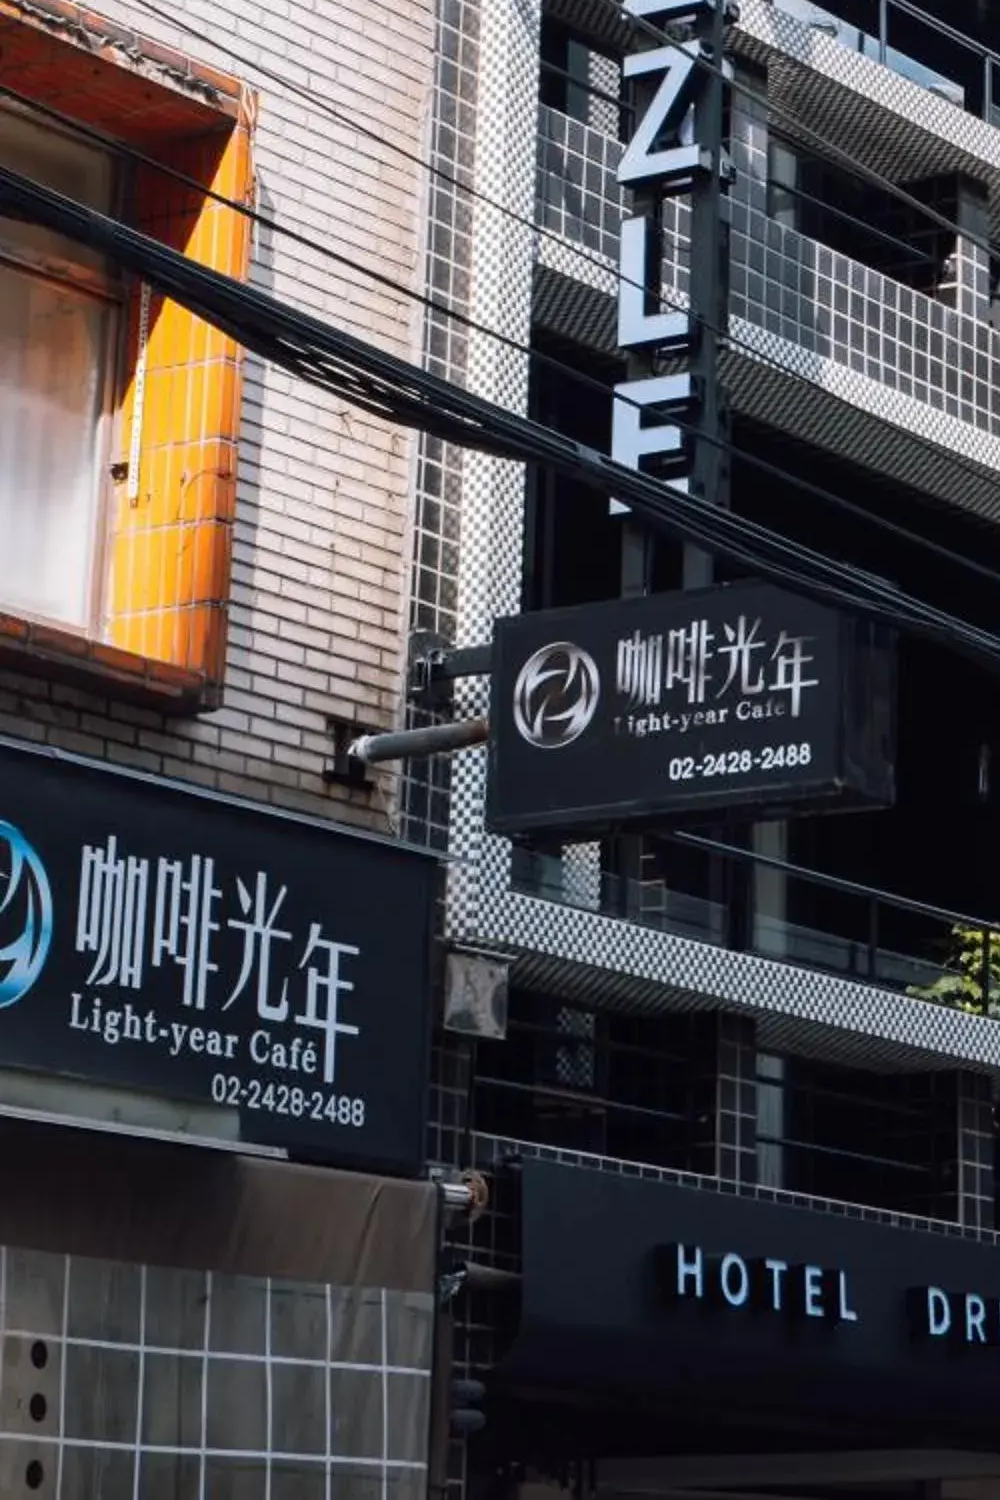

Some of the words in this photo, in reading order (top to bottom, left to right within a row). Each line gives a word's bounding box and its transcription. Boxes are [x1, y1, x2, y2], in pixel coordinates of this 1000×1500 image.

[616, 615, 819, 717] 咖啡光年
[669, 743, 811, 780] 02-2428-2488
[75, 835, 361, 1083] 咖啡光年
[69, 993, 239, 1058] Light-year
[250, 1029, 319, 1074] Café
[212, 1074, 366, 1127] 02-2428-2488
[676, 1243, 858, 1322] HOTEL
